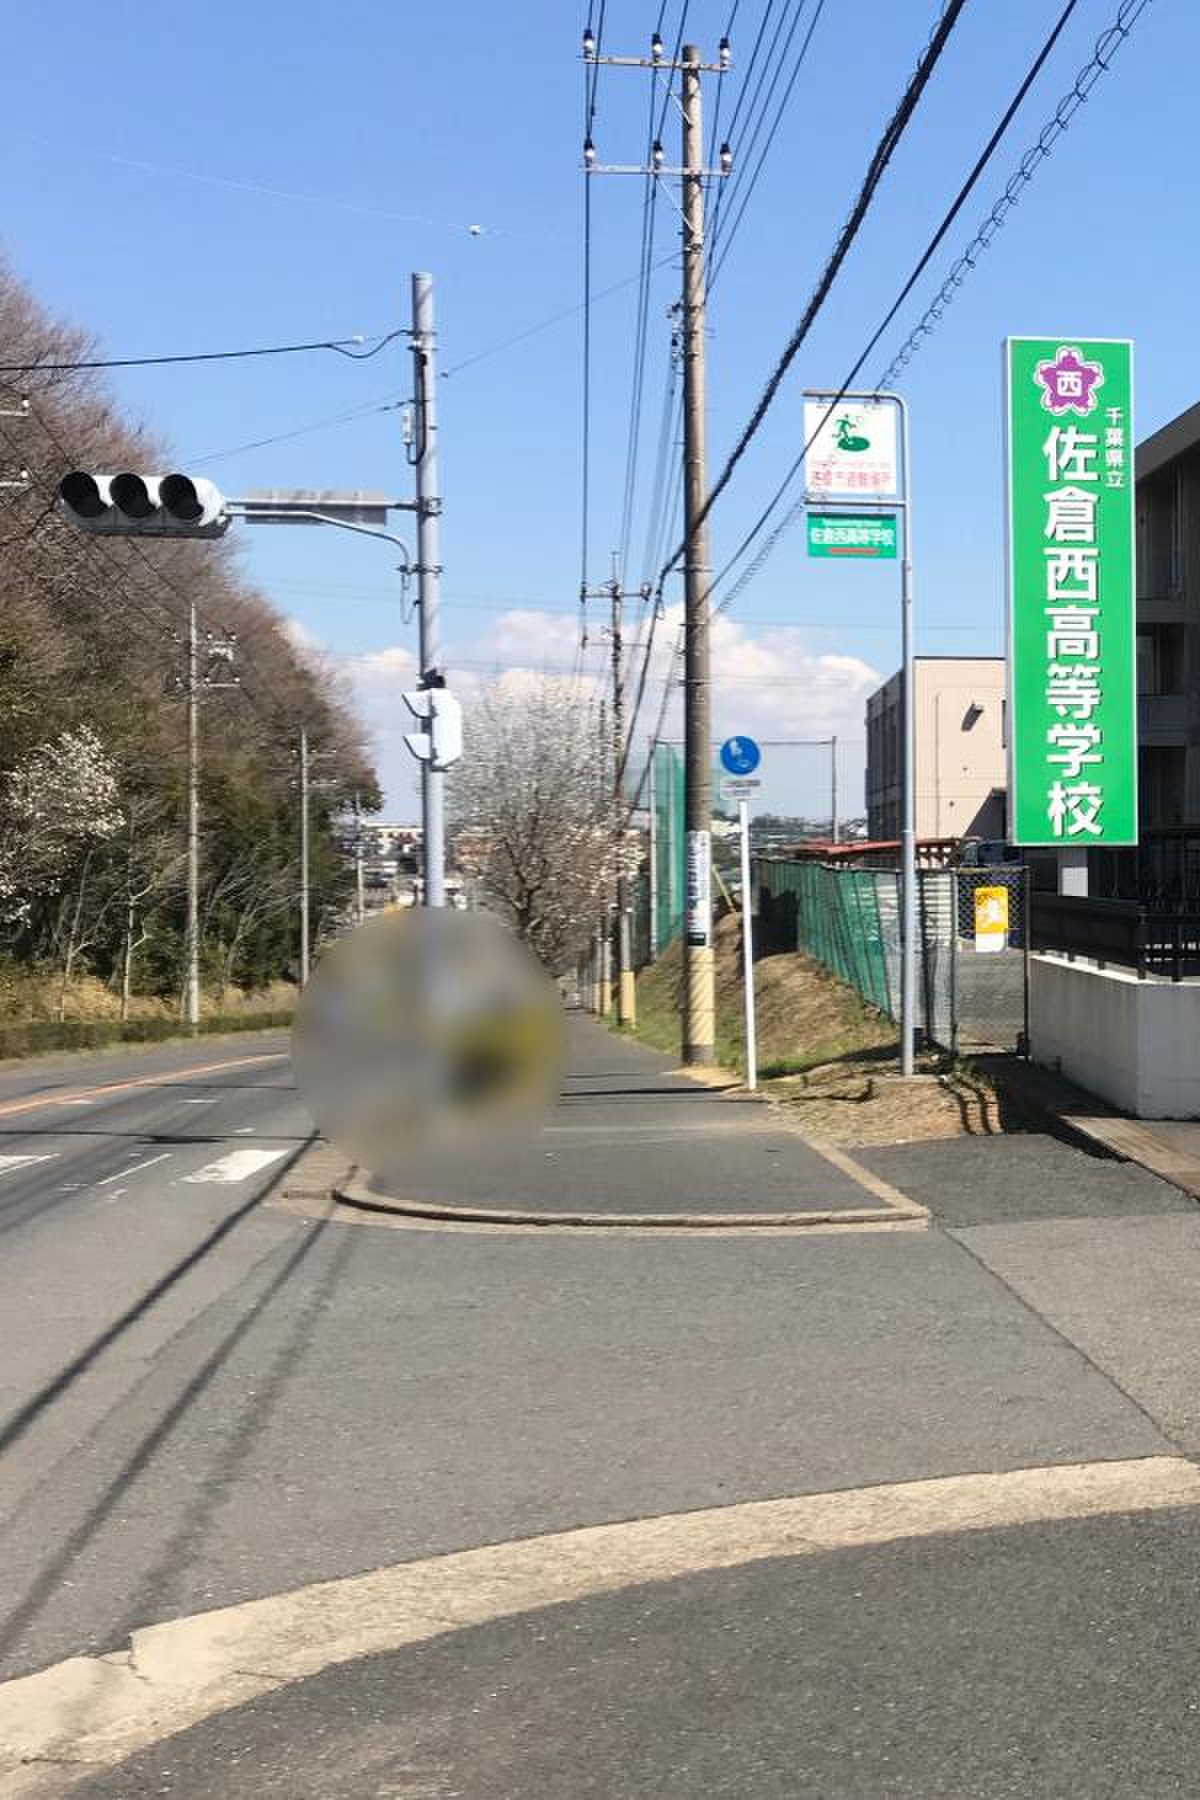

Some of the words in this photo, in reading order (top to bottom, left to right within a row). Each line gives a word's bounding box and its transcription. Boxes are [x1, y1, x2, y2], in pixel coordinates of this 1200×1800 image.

[1056, 371, 1083, 397] 西
[1106, 406, 1125, 488] 千葉県立
[1043, 425, 1104, 838] 佐倉西高等学校
